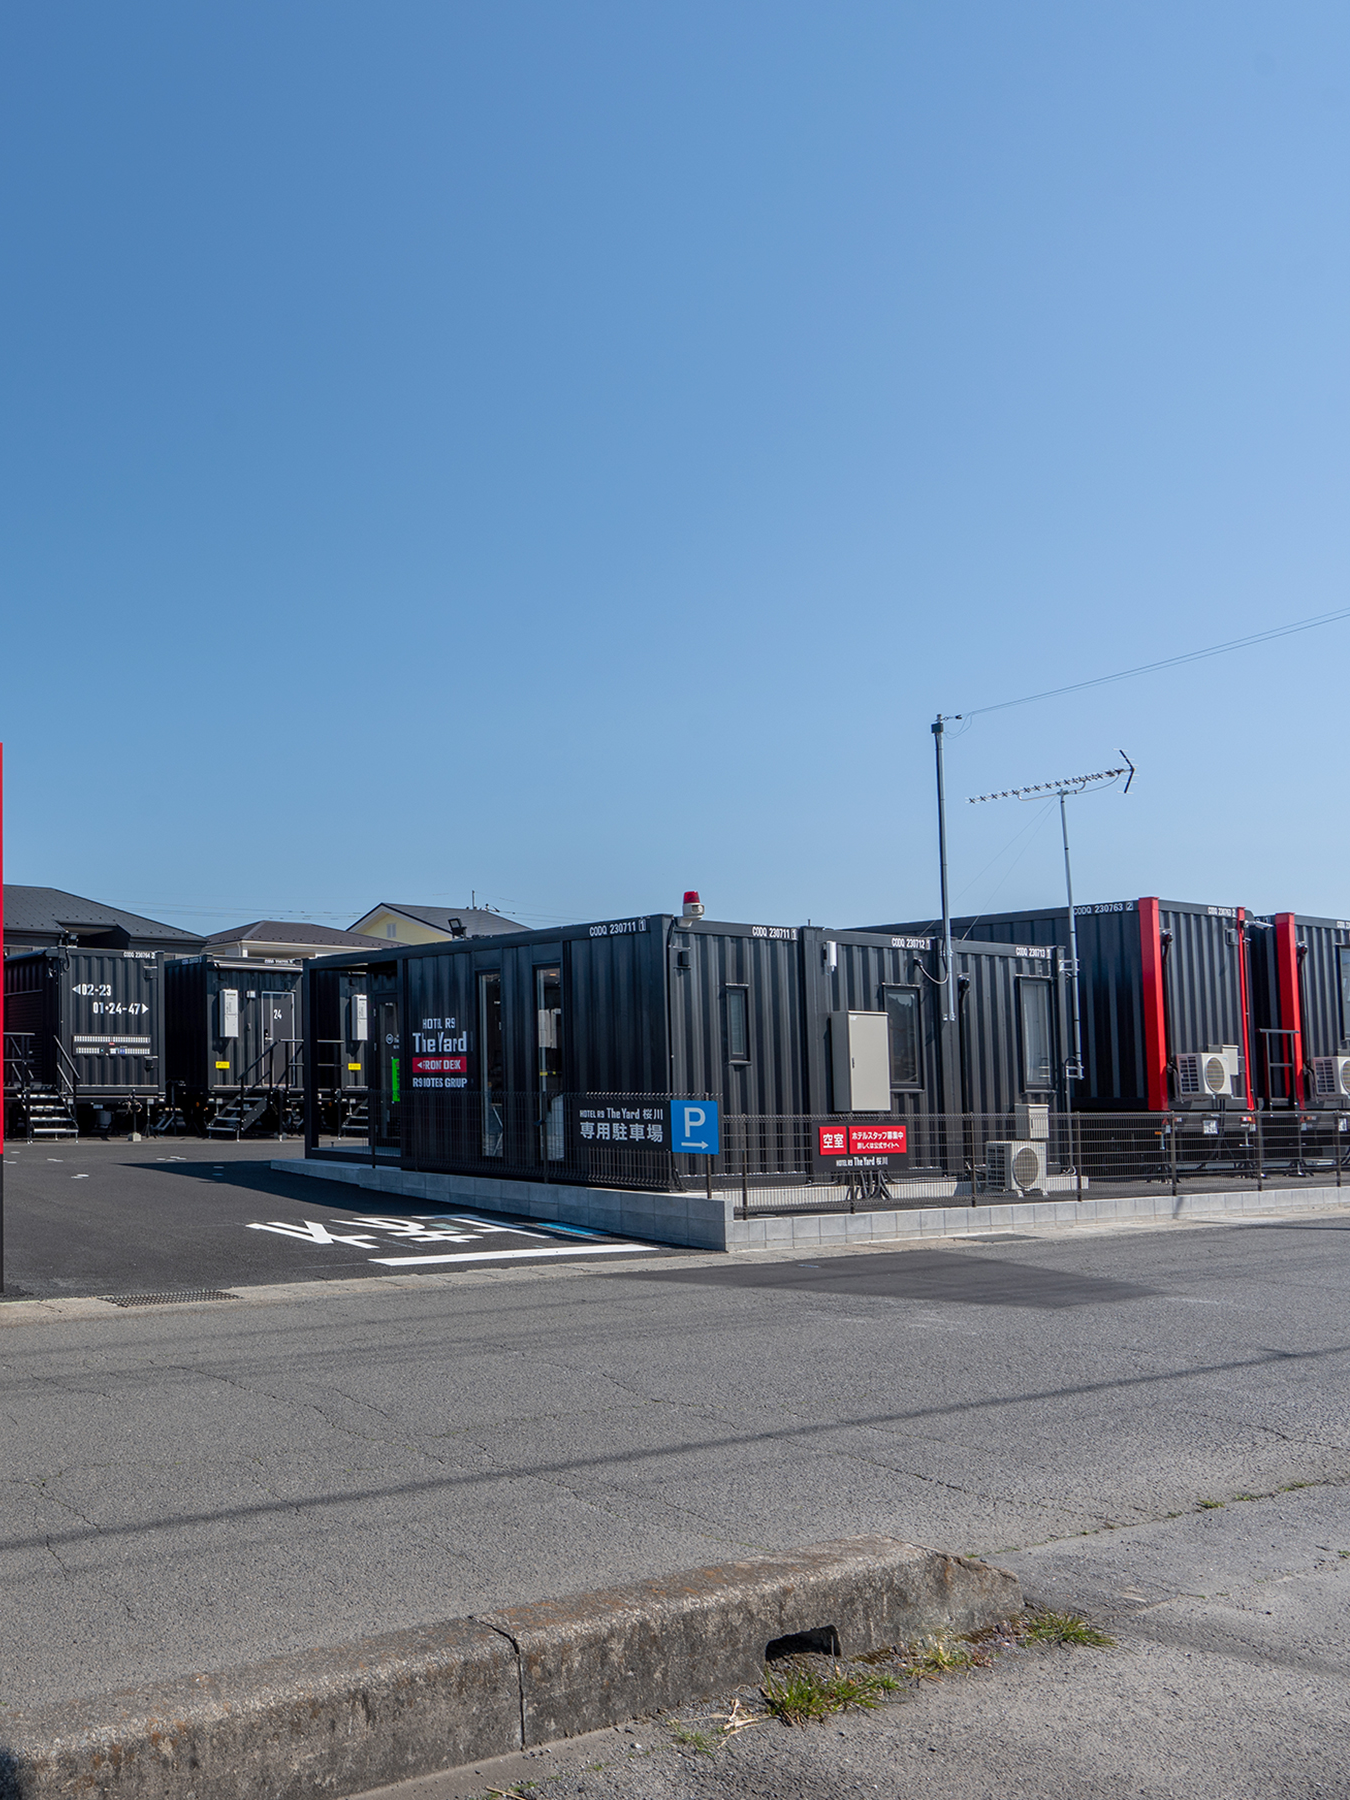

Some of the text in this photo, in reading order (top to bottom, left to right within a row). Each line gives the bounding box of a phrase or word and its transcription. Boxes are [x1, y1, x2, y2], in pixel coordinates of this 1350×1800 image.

[1094, 902, 1123, 913] 230763
[609, 921, 636, 934] 230711
[769, 927, 790, 939] 230711
[82, 983, 111, 996] 02-23
[273, 1008, 282, 1020] 24
[437, 1030, 467, 1052] Yard
[579, 1109, 596, 1119] HOTEL
[606, 1107, 621, 1119] The
[621, 1108, 640, 1120] Yard
[642, 1108, 664, 1120] 桜川
[684, 1107, 706, 1138] P
[580, 1121, 664, 1143] 専用駐車場
[823, 1133, 844, 1149] 空室
